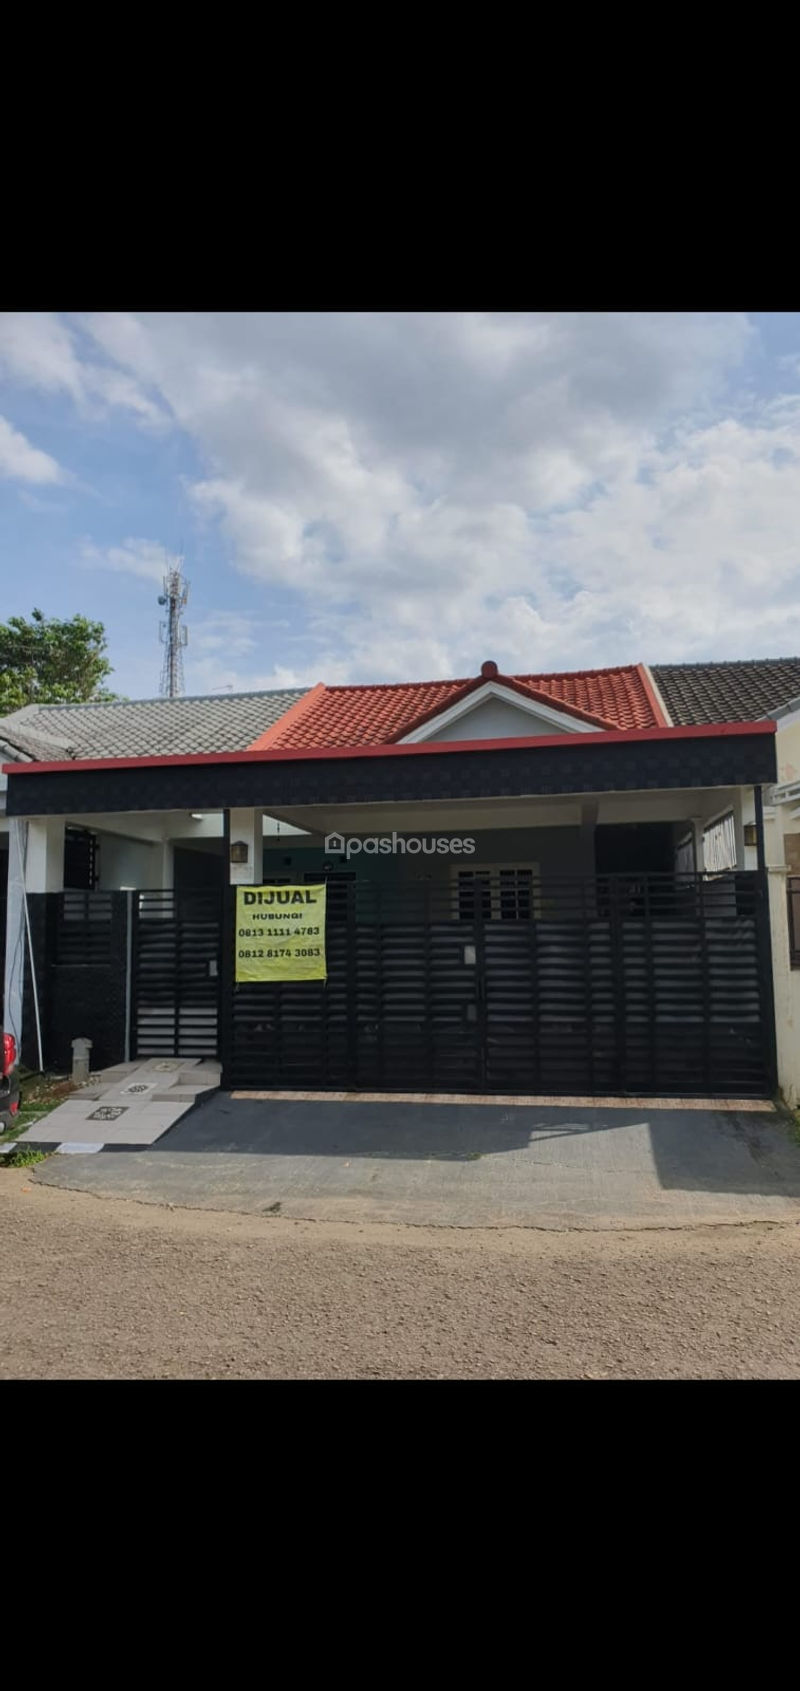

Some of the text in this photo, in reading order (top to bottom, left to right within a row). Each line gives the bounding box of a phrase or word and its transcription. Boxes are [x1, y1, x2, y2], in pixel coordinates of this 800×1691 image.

[243, 890, 317, 905] DIJUAL
[238, 928, 264, 937] 0813
[267, 928, 291, 936] 1111
[238, 949, 264, 958] 0812
[267, 949, 291, 958] 8174
